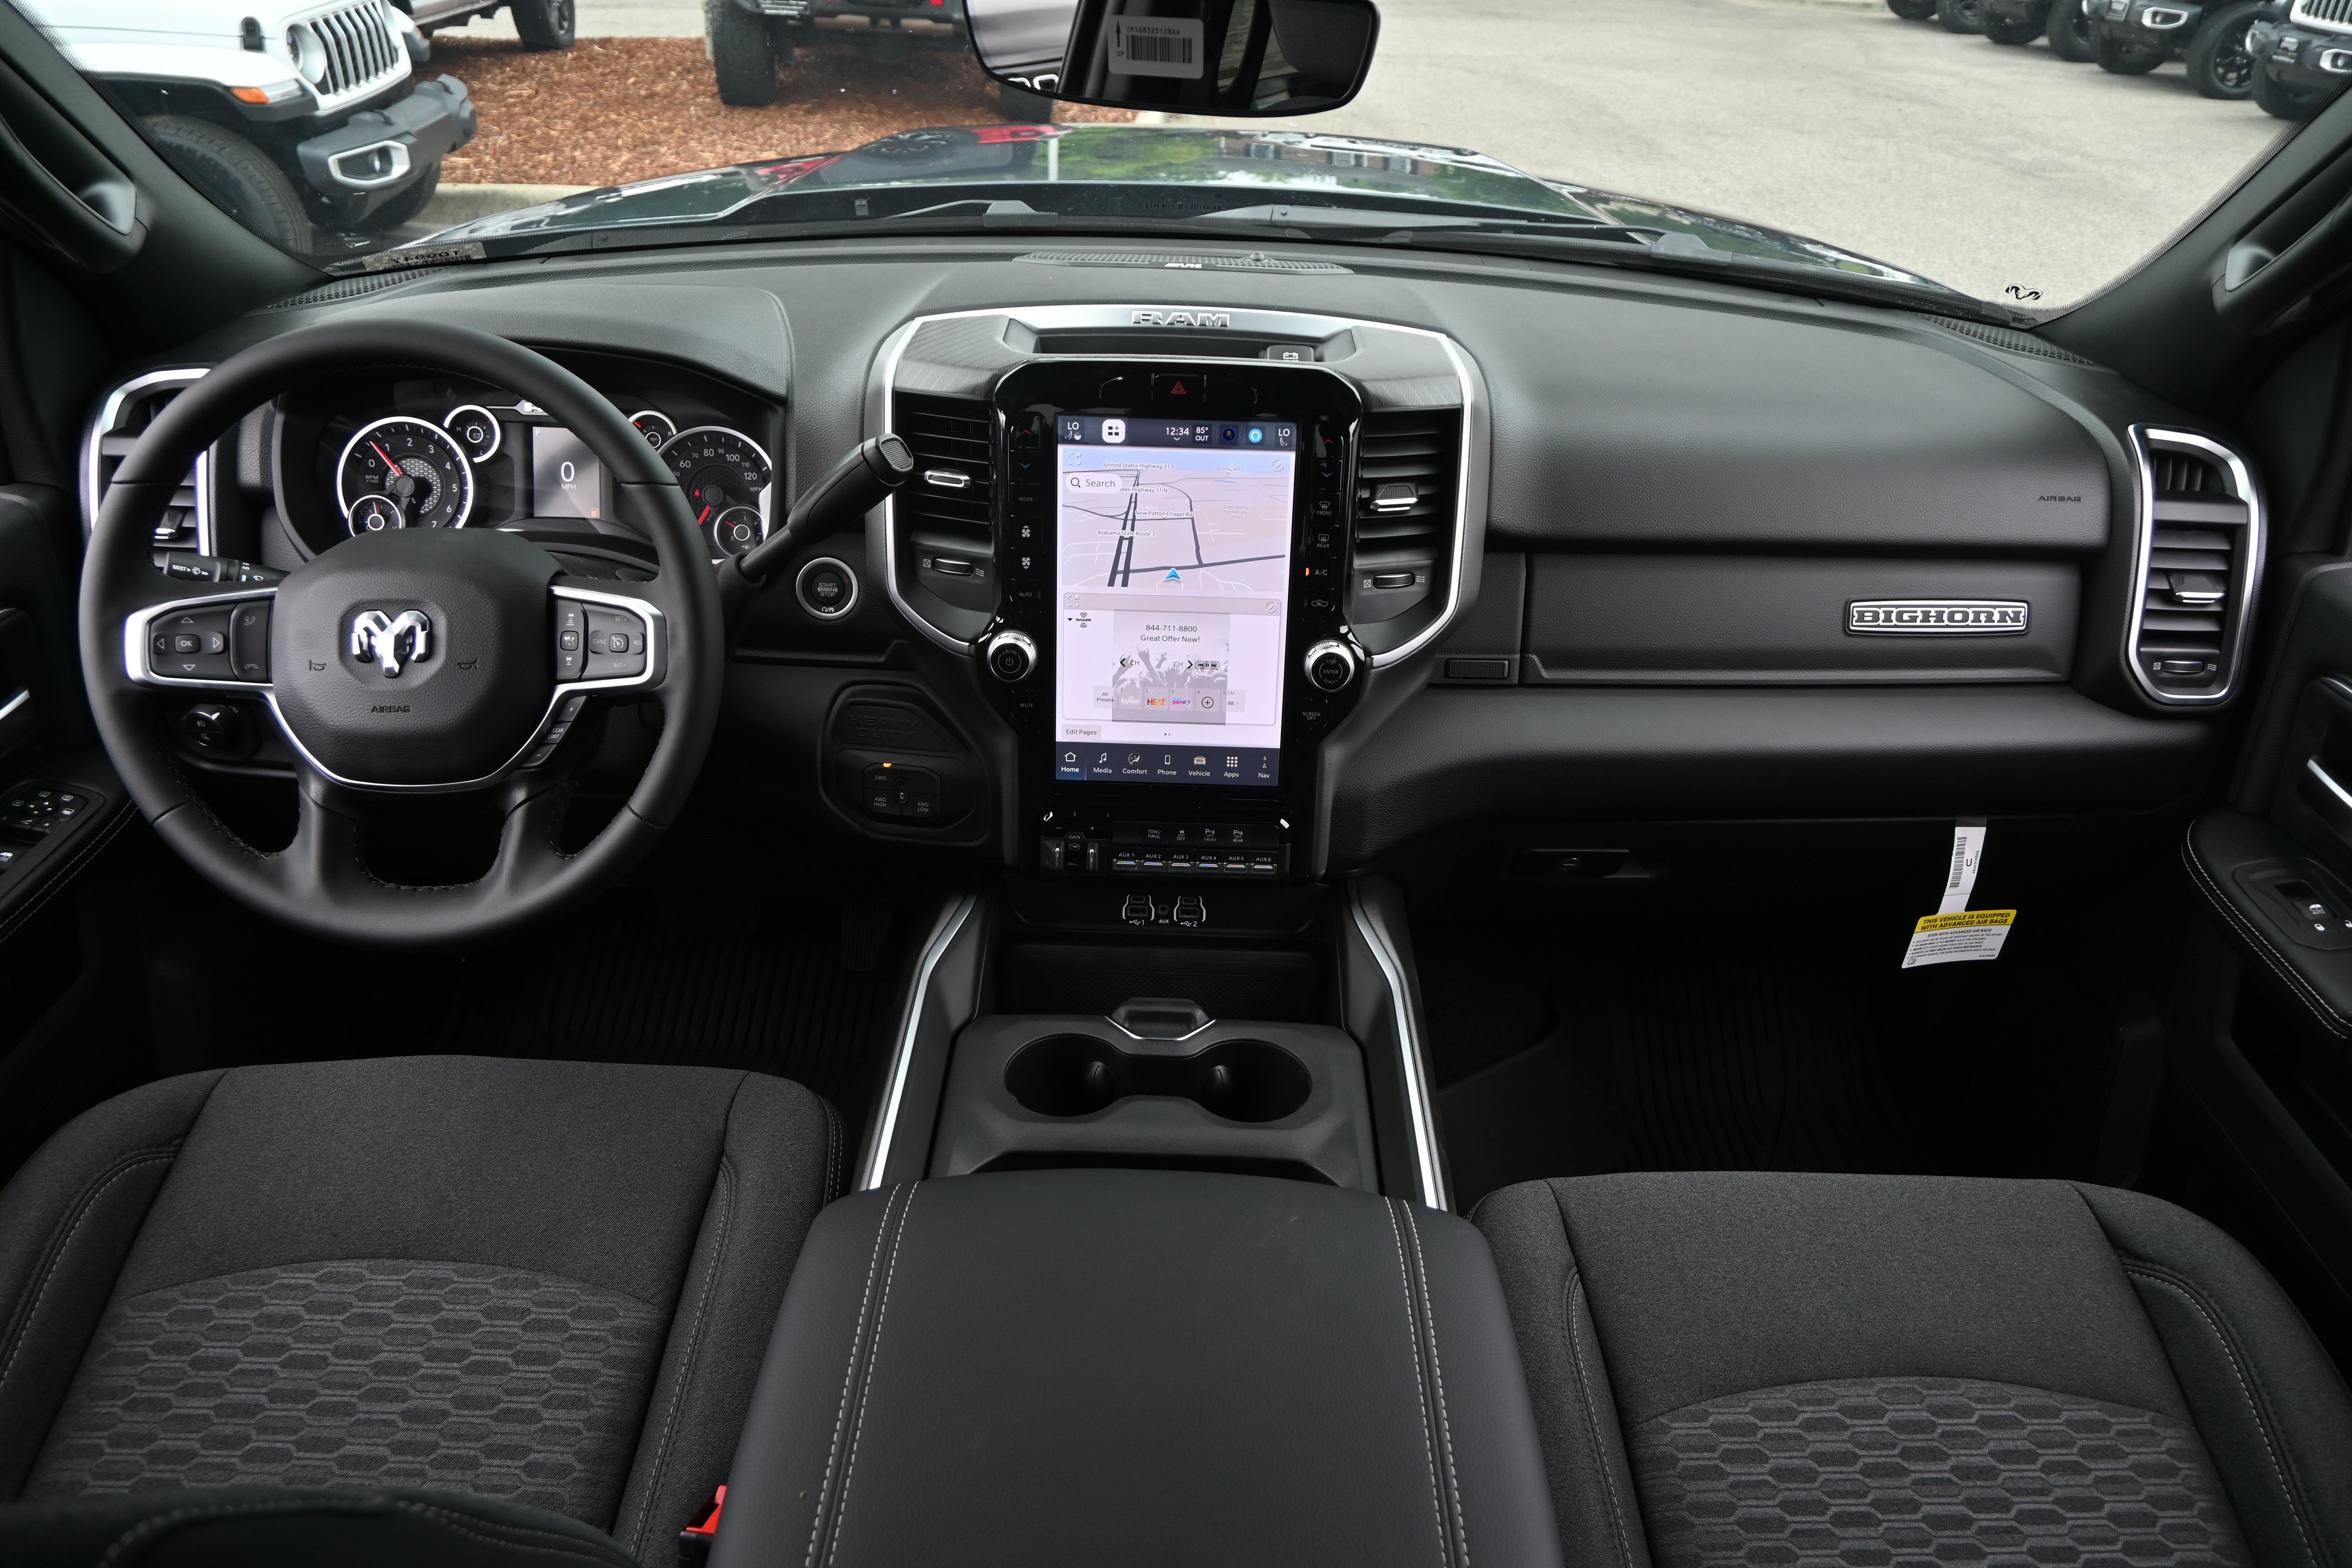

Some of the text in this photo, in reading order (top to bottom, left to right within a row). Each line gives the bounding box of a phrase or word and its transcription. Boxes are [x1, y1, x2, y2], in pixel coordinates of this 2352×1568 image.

[1127, 26, 1180, 35] (P)68325128AA
[1131, 311, 1230, 327] RAM
[1067, 422, 1079, 430] LO
[1166, 427, 1189, 436] 12:34
[1279, 428, 1290, 437] LO
[407, 438, 413, 446] 2
[428, 445, 434, 453] 3
[704, 449, 714, 457] 80
[368, 459, 375, 467] 0
[445, 462, 451, 470] 4
[561, 461, 574, 482] 0
[1086, 479, 1115, 487] Search
[452, 484, 457, 492] 5
[446, 505, 452, 513] 6
[1853, 608, 2025, 625] BIGHORN
[847, 714, 919, 730] HEAVY
[855, 727, 914, 741] DUTY
[1079, 729, 1097, 737] Pages
[1224, 771, 1239, 779] Apps
[1966, 858, 1972, 867] U
[1938, 920, 1975, 928] ADVANCED
